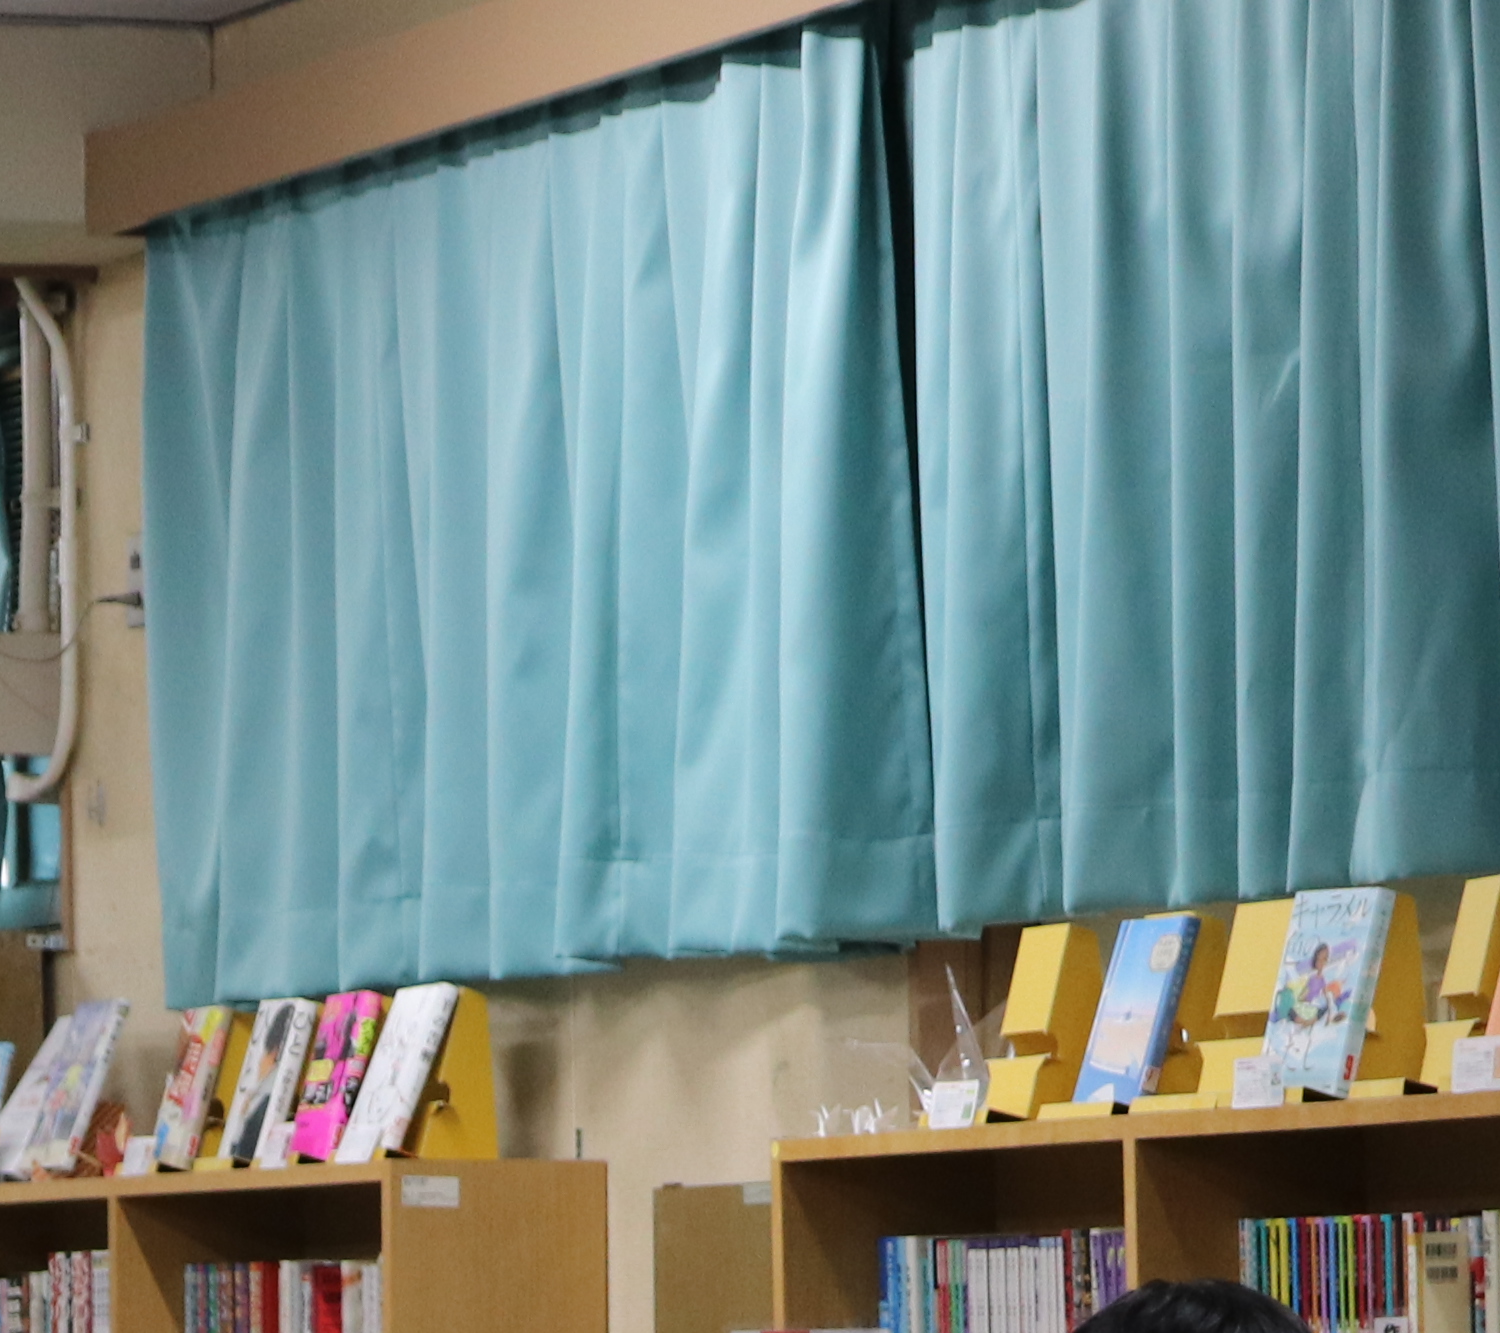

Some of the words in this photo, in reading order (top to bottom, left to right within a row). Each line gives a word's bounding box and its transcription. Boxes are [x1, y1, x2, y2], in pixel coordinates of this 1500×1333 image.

[1293, 893, 1369, 928] キャラメル
